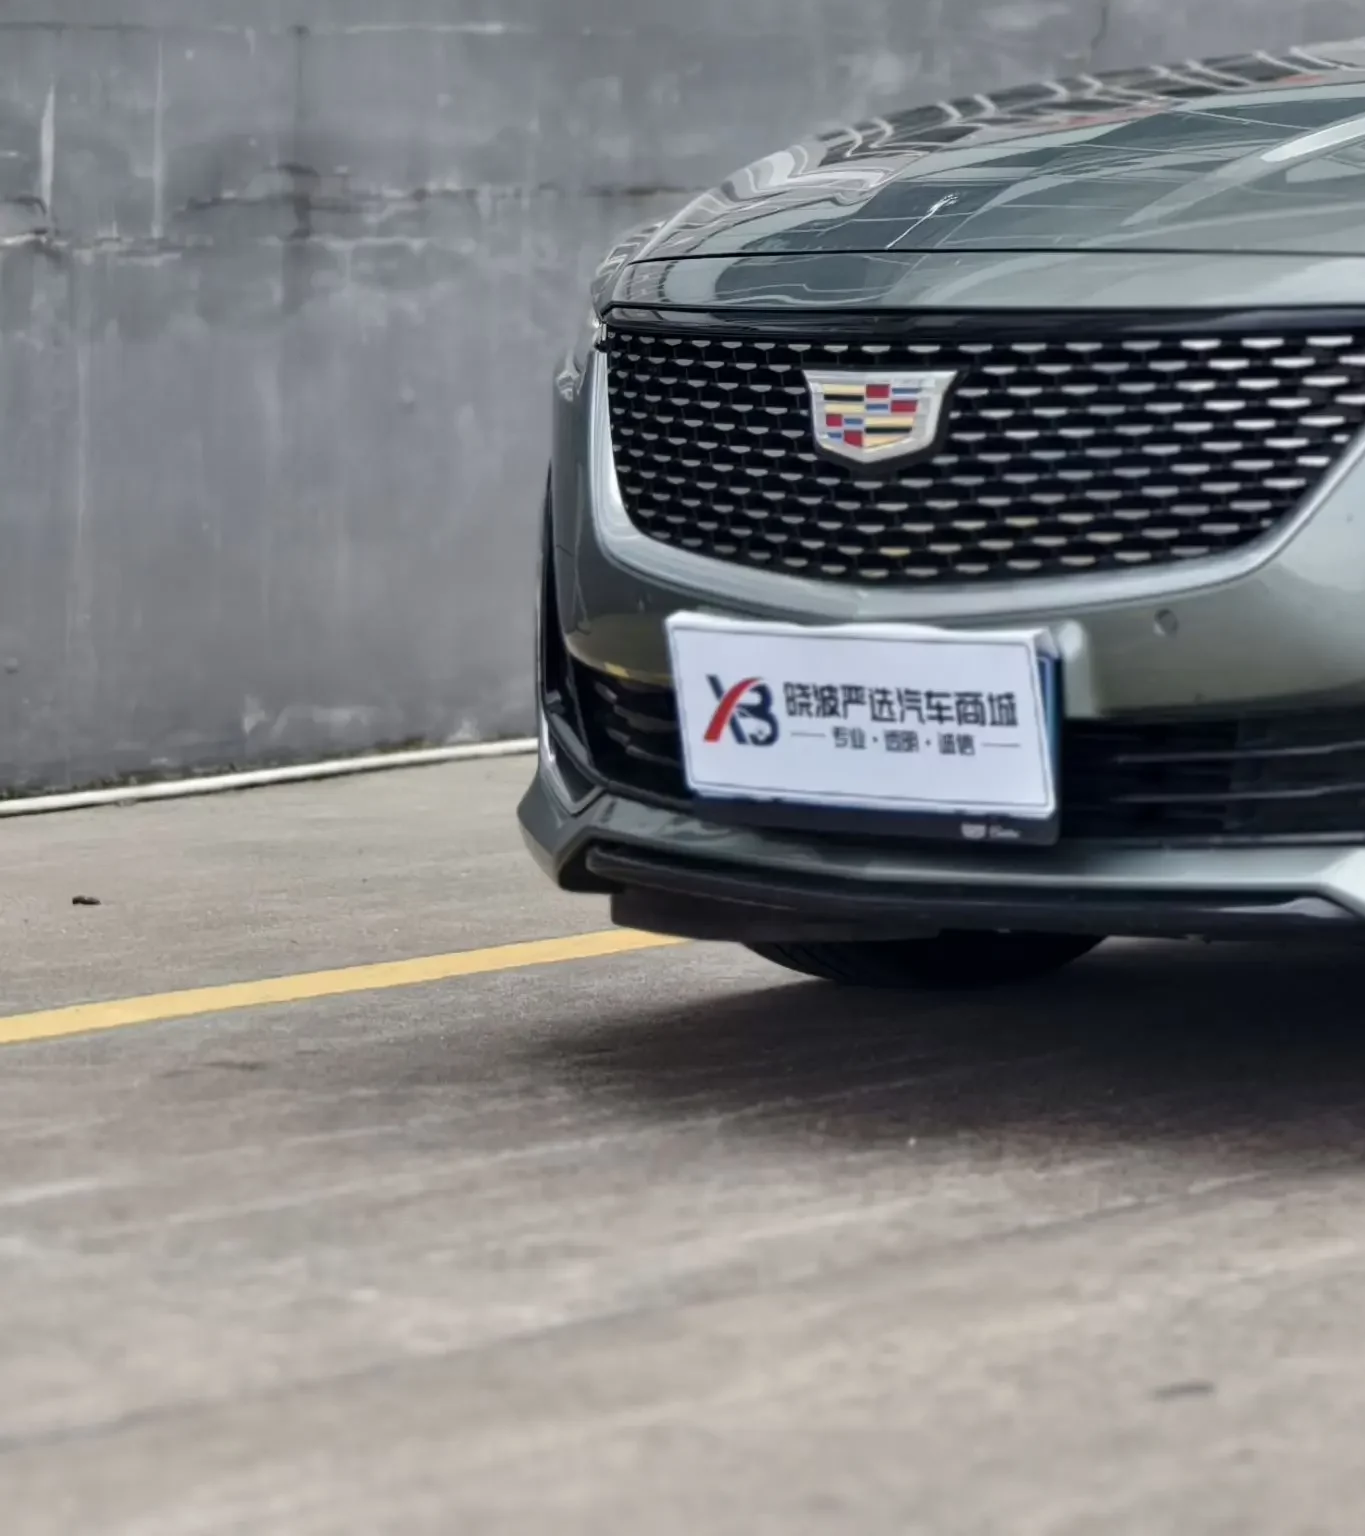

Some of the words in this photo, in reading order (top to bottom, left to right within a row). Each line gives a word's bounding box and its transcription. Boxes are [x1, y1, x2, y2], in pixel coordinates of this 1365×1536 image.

[783, 681, 1019, 727] 晓波严选汽车商城
